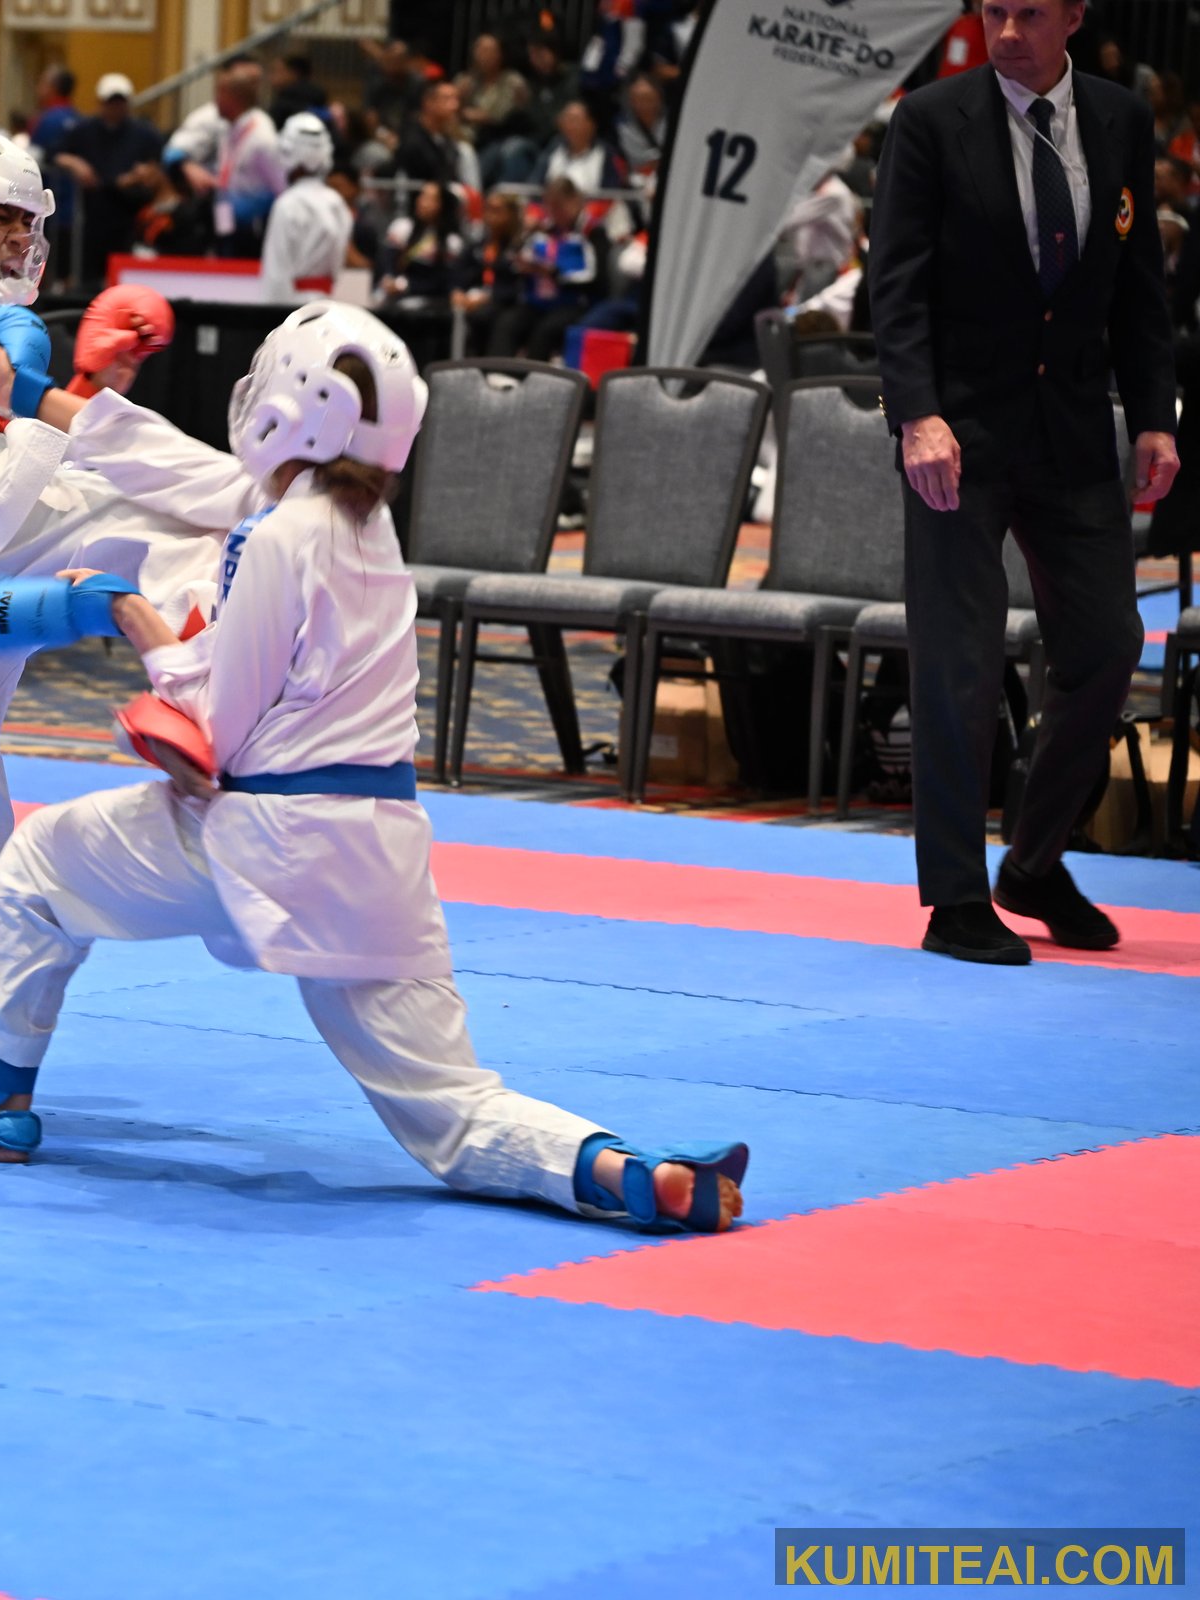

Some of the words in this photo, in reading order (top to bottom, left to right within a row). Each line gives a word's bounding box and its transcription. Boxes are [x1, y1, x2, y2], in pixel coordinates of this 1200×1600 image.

[748, 14, 895, 69] KARATE-DO
[783, 5, 868, 39] NATIONAL
[702, 128, 758, 205] 12
